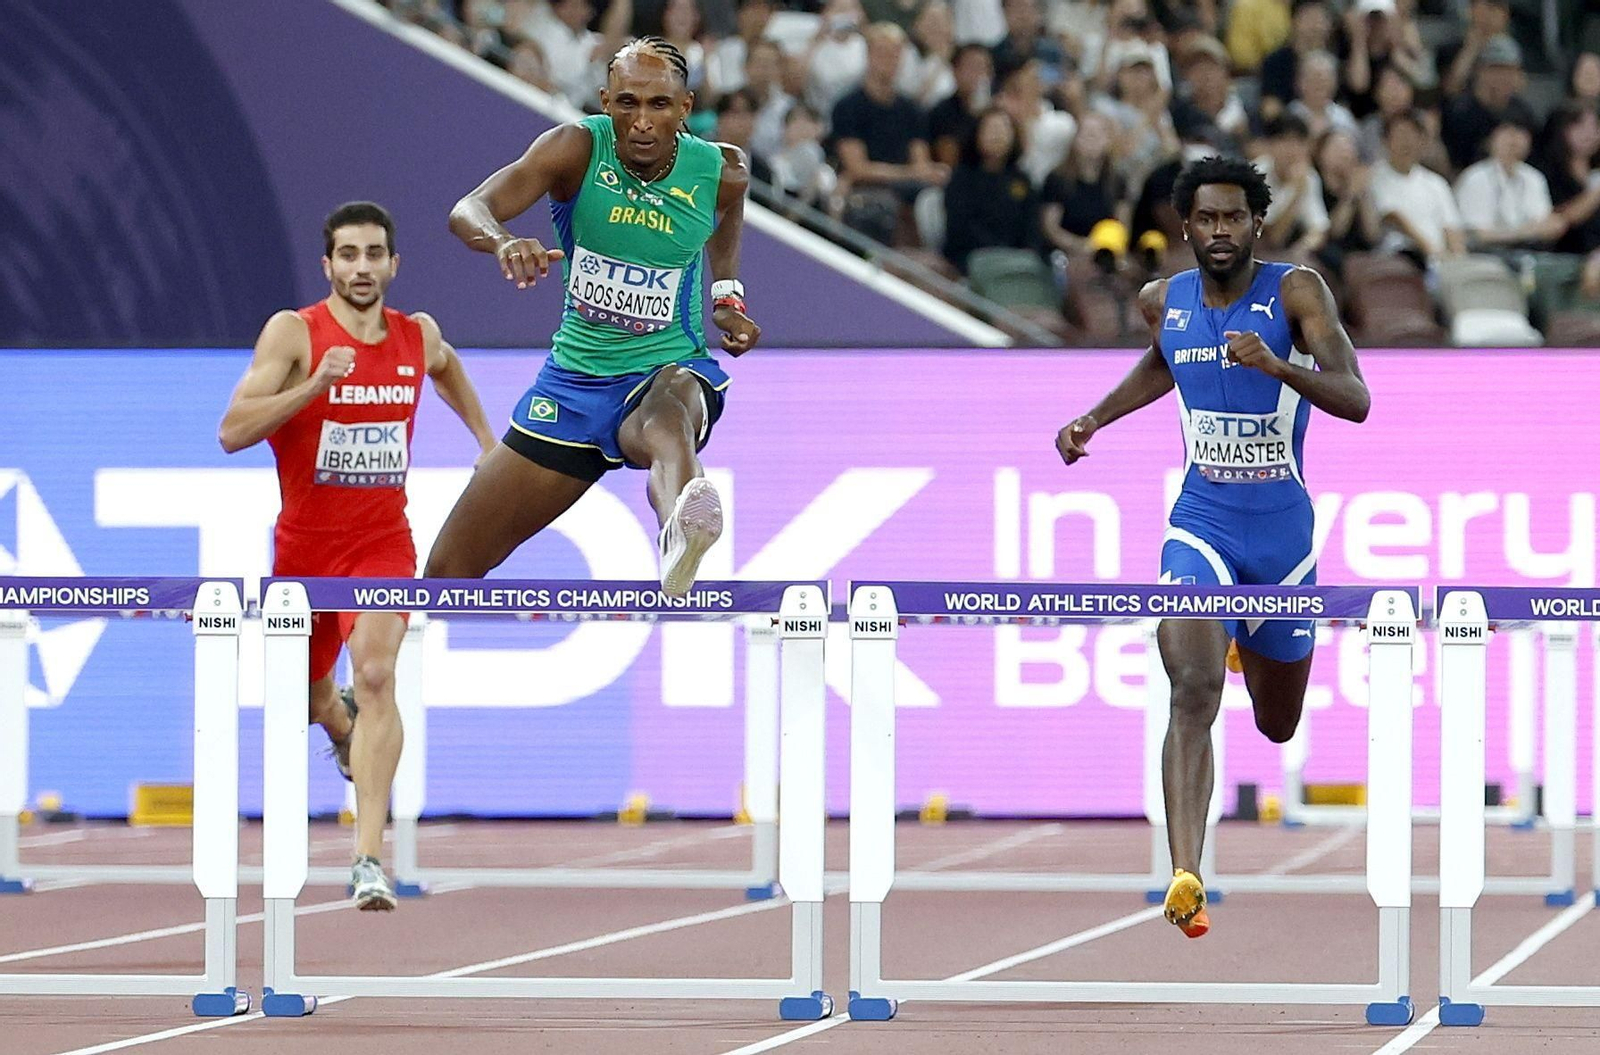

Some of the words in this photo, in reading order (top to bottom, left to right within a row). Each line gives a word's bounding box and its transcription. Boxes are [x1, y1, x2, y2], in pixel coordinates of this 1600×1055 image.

[608, 206, 674, 234] BRASIL
[602, 259, 672, 290] TDK
[571, 275, 582, 296] A.
[584, 281, 613, 307] DOS
[615, 290, 670, 317] SANTOS
[1174, 346, 1217, 364] BRITISH
[329, 384, 415, 405] LEBANON
[347, 426, 399, 445] TDK
[1216, 416, 1281, 438] TDK
[322, 450, 403, 470] IBRAHIM
[1194, 440, 1285, 463] McMASTER
[994, 466, 1120, 579] In
[353, 588, 430, 606] WORLD
[437, 589, 551, 607] ATHLETICS
[557, 589, 733, 608] CHAMPIONSHIPS
[945, 593, 1021, 611] WORLD
[1028, 594, 1142, 612] ATHLETICS
[1148, 595, 1324, 614] CHAMPIONSHIPS
[200, 617, 236, 629] NISHI
[267, 617, 304, 629] NISHI
[784, 620, 822, 632] NISHI
[854, 621, 891, 633] NISHI
[1373, 626, 1410, 637] NISHI
[1445, 626, 1482, 638] NISHI
